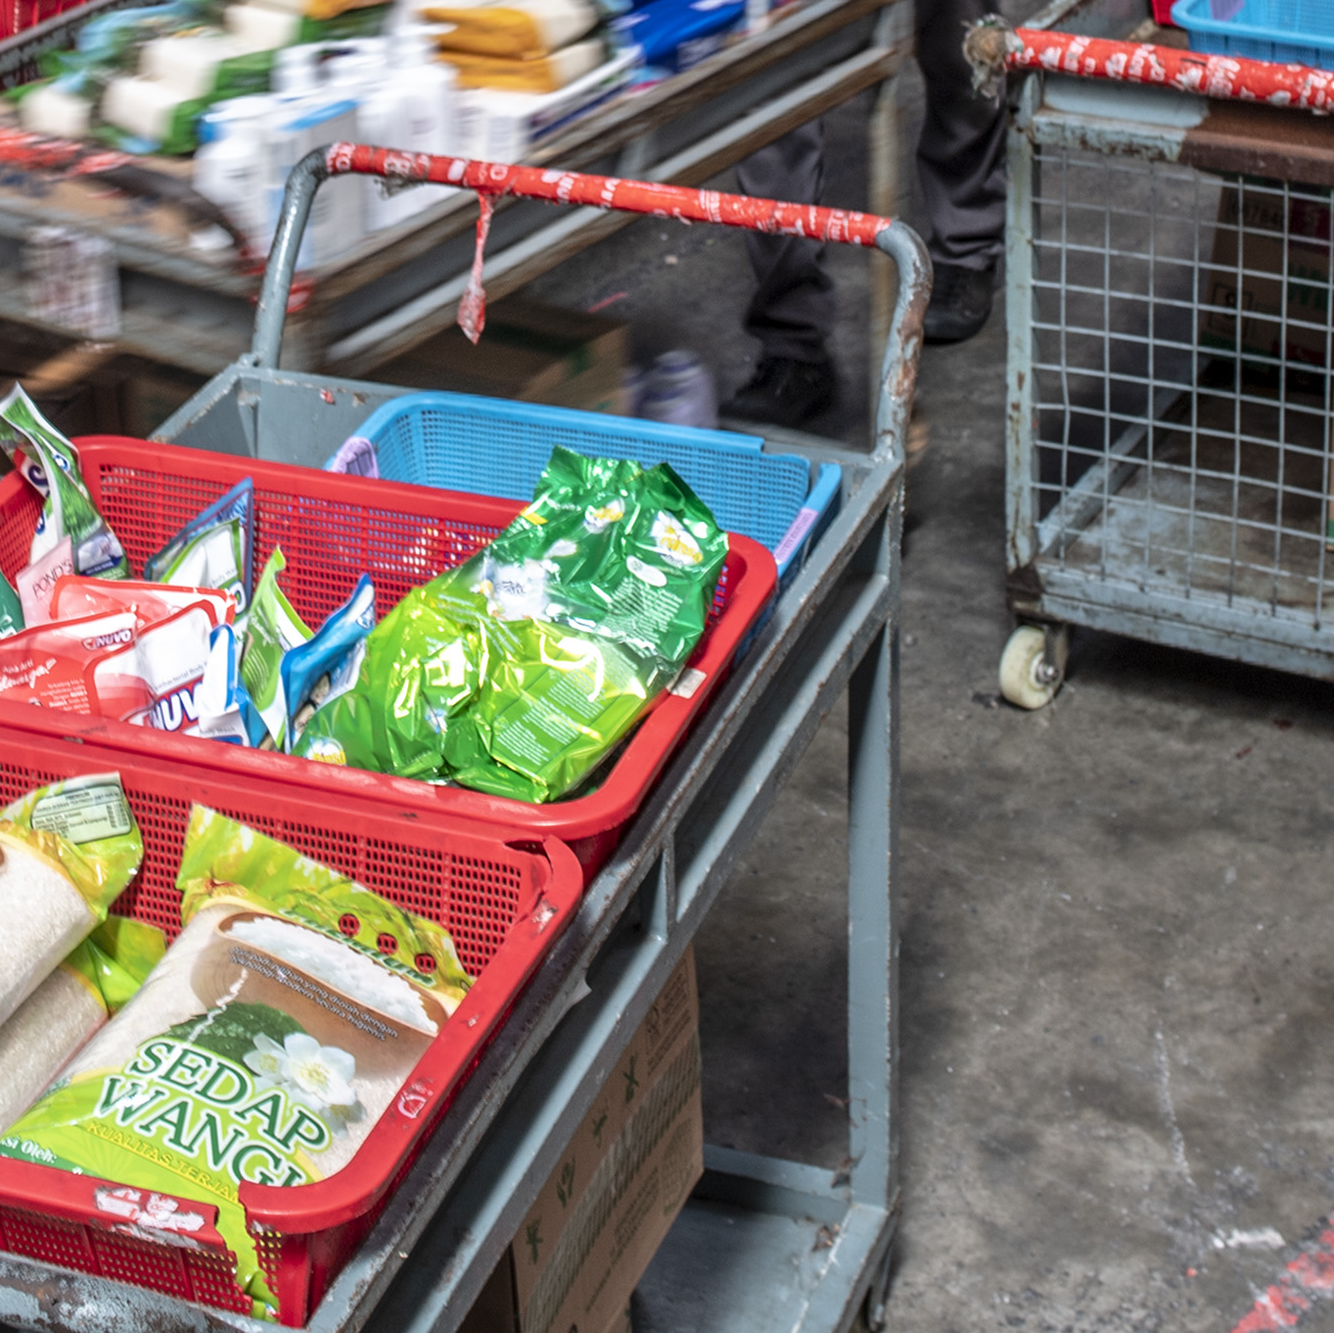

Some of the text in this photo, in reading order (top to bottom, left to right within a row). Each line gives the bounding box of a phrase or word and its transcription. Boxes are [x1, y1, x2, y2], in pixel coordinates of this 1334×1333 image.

[95, 628, 133, 650] NUVO
[148, 680, 205, 733] NUV
[130, 1041, 329, 1152] SEDAP
[21, 1137, 58, 1164] Oleh:
[87, 1120, 175, 1167] KUALITAS
[98, 1076, 310, 1188] WANGI
